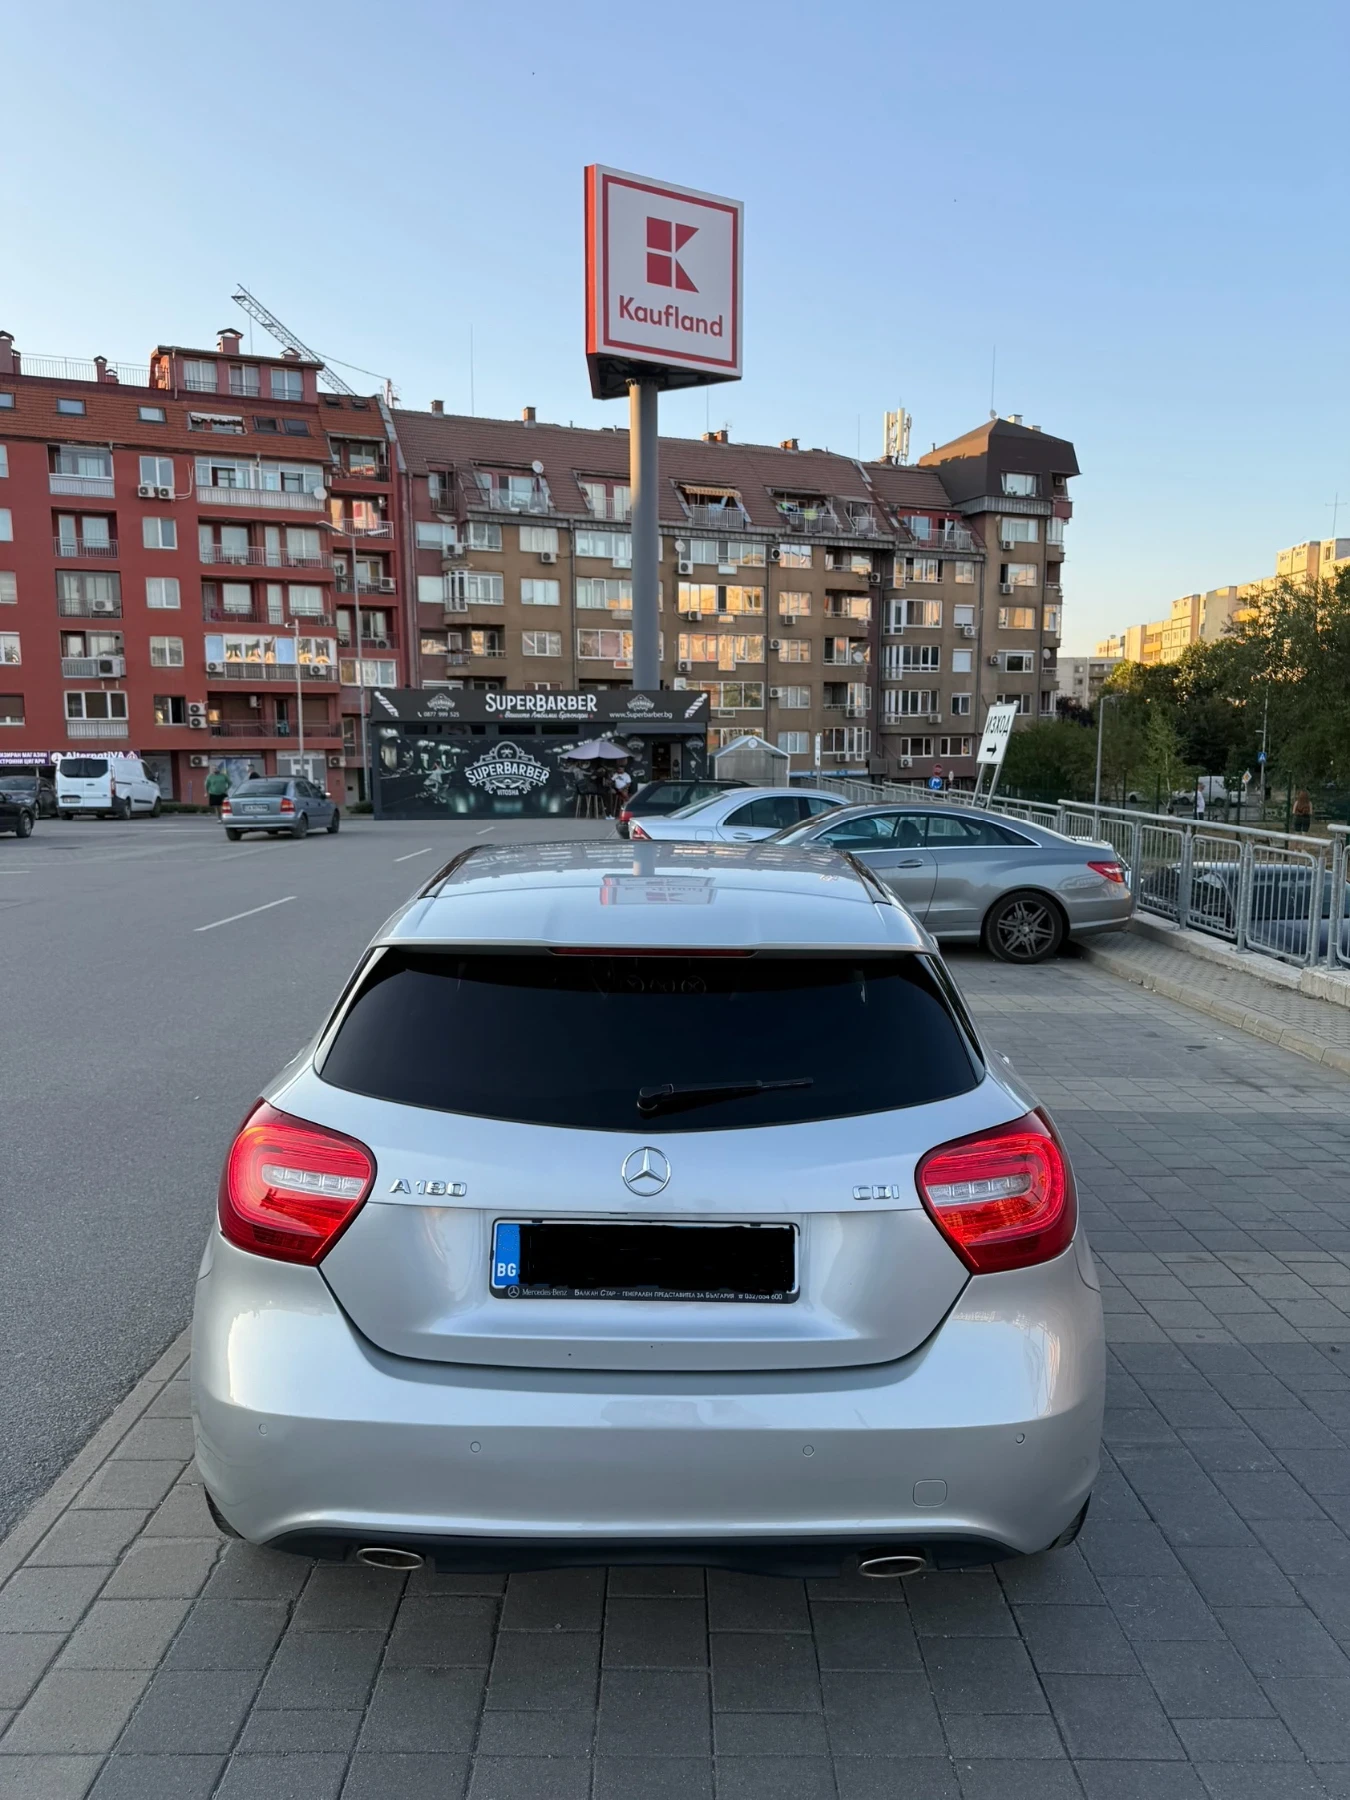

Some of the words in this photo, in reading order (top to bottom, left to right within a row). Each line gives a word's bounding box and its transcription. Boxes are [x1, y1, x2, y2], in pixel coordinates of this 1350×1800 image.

[619, 295, 723, 337] Kaufland
[609, 711, 673, 719] www.Superbarber.bg
[985, 714, 1010, 737] ИЗХОД
[465, 762, 549, 784] SUPERBARBER
[389, 1179, 411, 1194] A
[416, 1180, 467, 1197] 180
[852, 1185, 899, 1200] CDI
[497, 1262, 517, 1277] BG
[522, 1288, 567, 1296] Mercedes-Benz
[705, 1291, 735, 1299] БЪЛГАРИЯ
